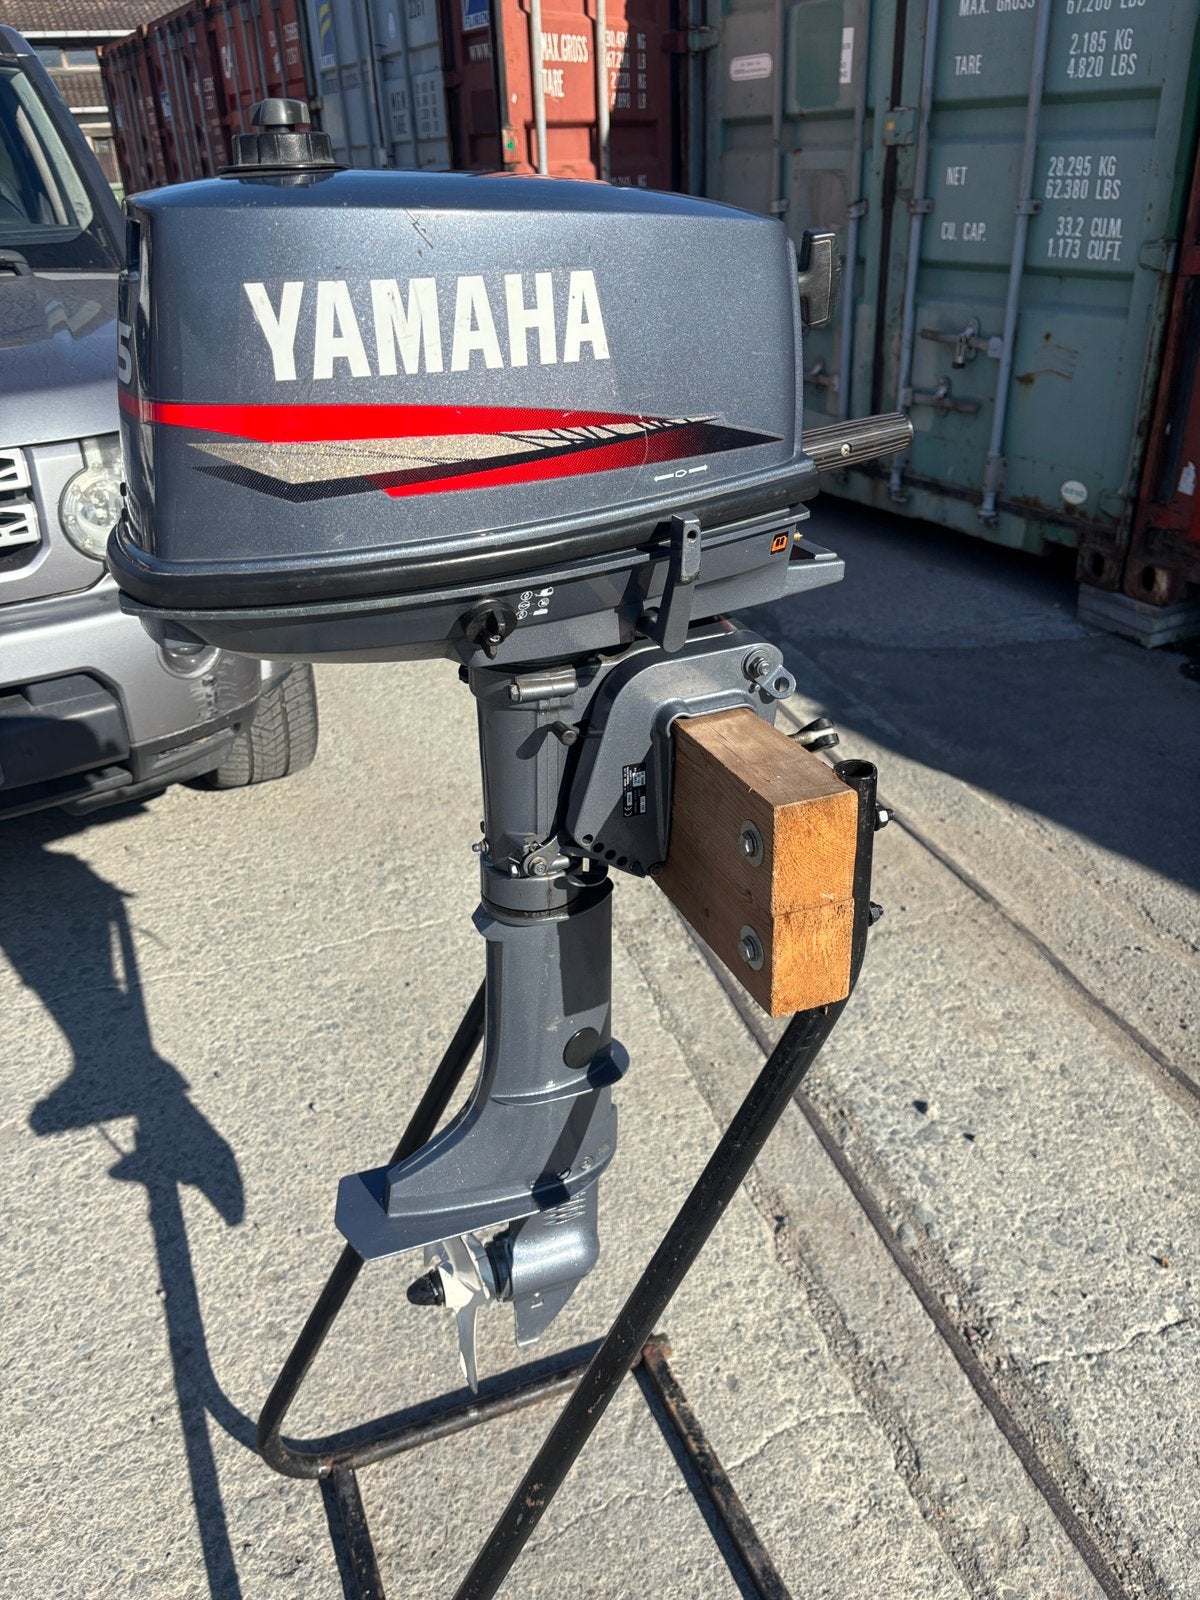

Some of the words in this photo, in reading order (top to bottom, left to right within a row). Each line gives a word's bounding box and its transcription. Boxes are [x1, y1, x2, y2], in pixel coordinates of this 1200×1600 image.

[958, 0, 990, 16] MAX.
[1069, 31, 1107, 55] 2.185
[1114, 28, 1133, 51] KG
[955, 54, 983, 76] TARE
[1066, 56, 1103, 79] 4.820
[1110, 53, 1137, 76] LBS
[541, 68, 565, 98] TARE
[945, 166, 968, 187] NET
[1048, 156, 1092, 177] 28.295
[1098, 156, 1117, 177] KG
[1044, 179, 1089, 200] 62.380
[1095, 179, 1121, 200] LBS
[962, 222, 987, 242] CAP.
[1056, 216, 1084, 237] 33.2
[1047, 238, 1081, 260] 1.173
[244, 269, 610, 382] YAMAHA
[118, 321, 132, 385] 5
